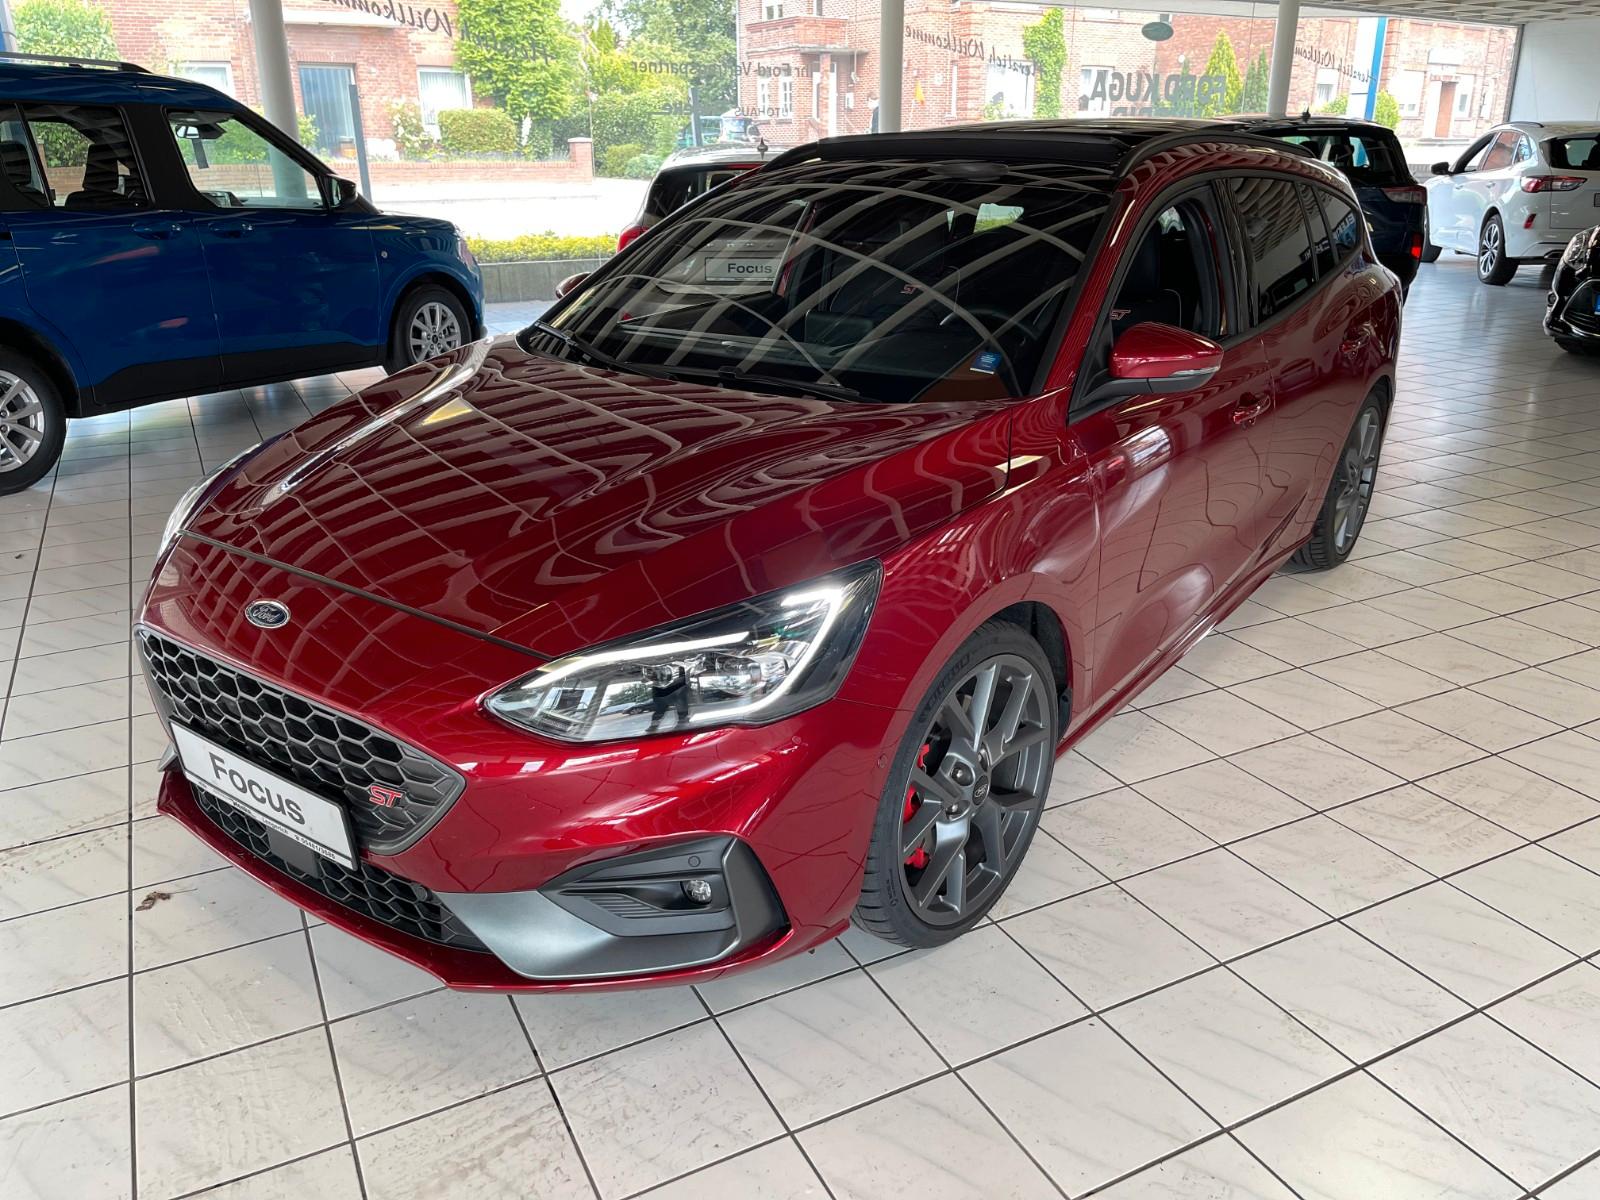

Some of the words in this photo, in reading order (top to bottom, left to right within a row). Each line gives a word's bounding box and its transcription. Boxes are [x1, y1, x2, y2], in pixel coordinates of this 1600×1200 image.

[727, 263, 773, 274] Focus
[208, 751, 306, 826] Focus
[369, 785, 403, 808] ST
